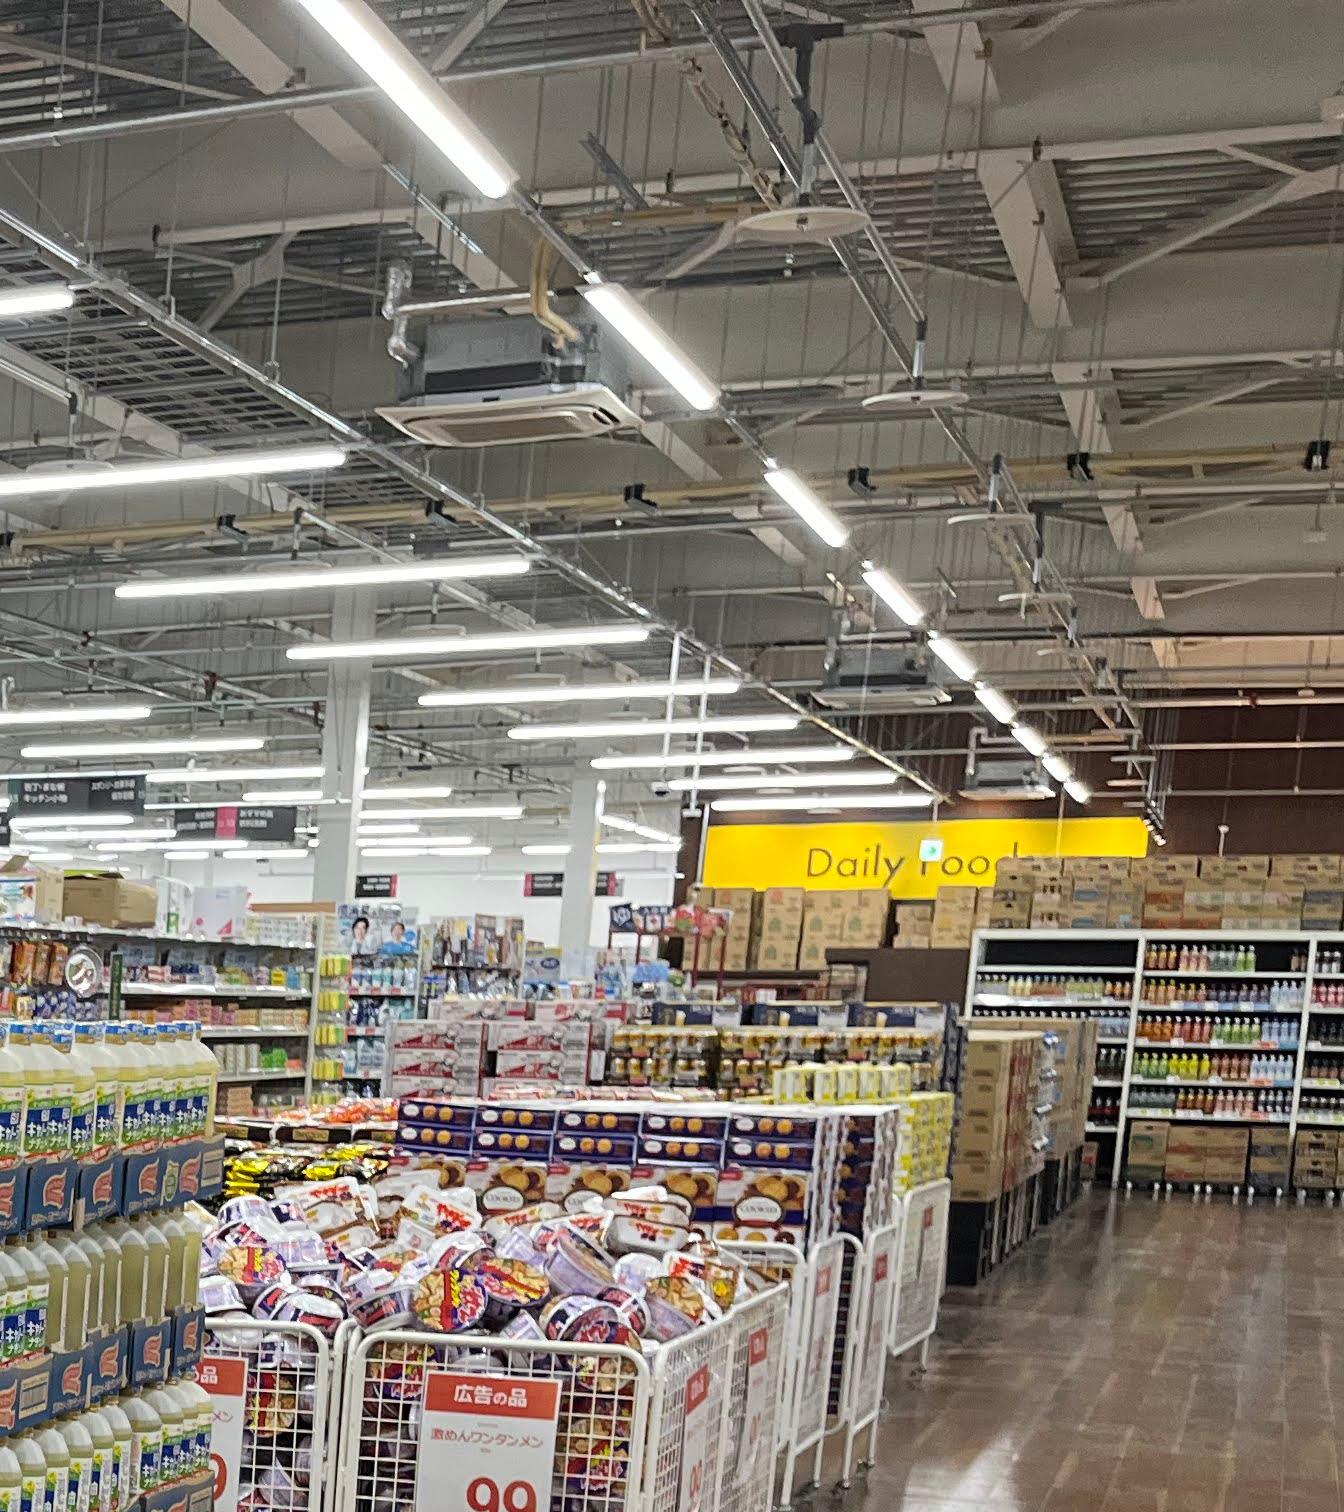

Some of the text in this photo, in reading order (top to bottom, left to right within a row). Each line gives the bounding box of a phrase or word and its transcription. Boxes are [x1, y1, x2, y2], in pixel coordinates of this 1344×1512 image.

[807, 843, 906, 887] Daily
[455, 1385, 527, 1408] 広告の品
